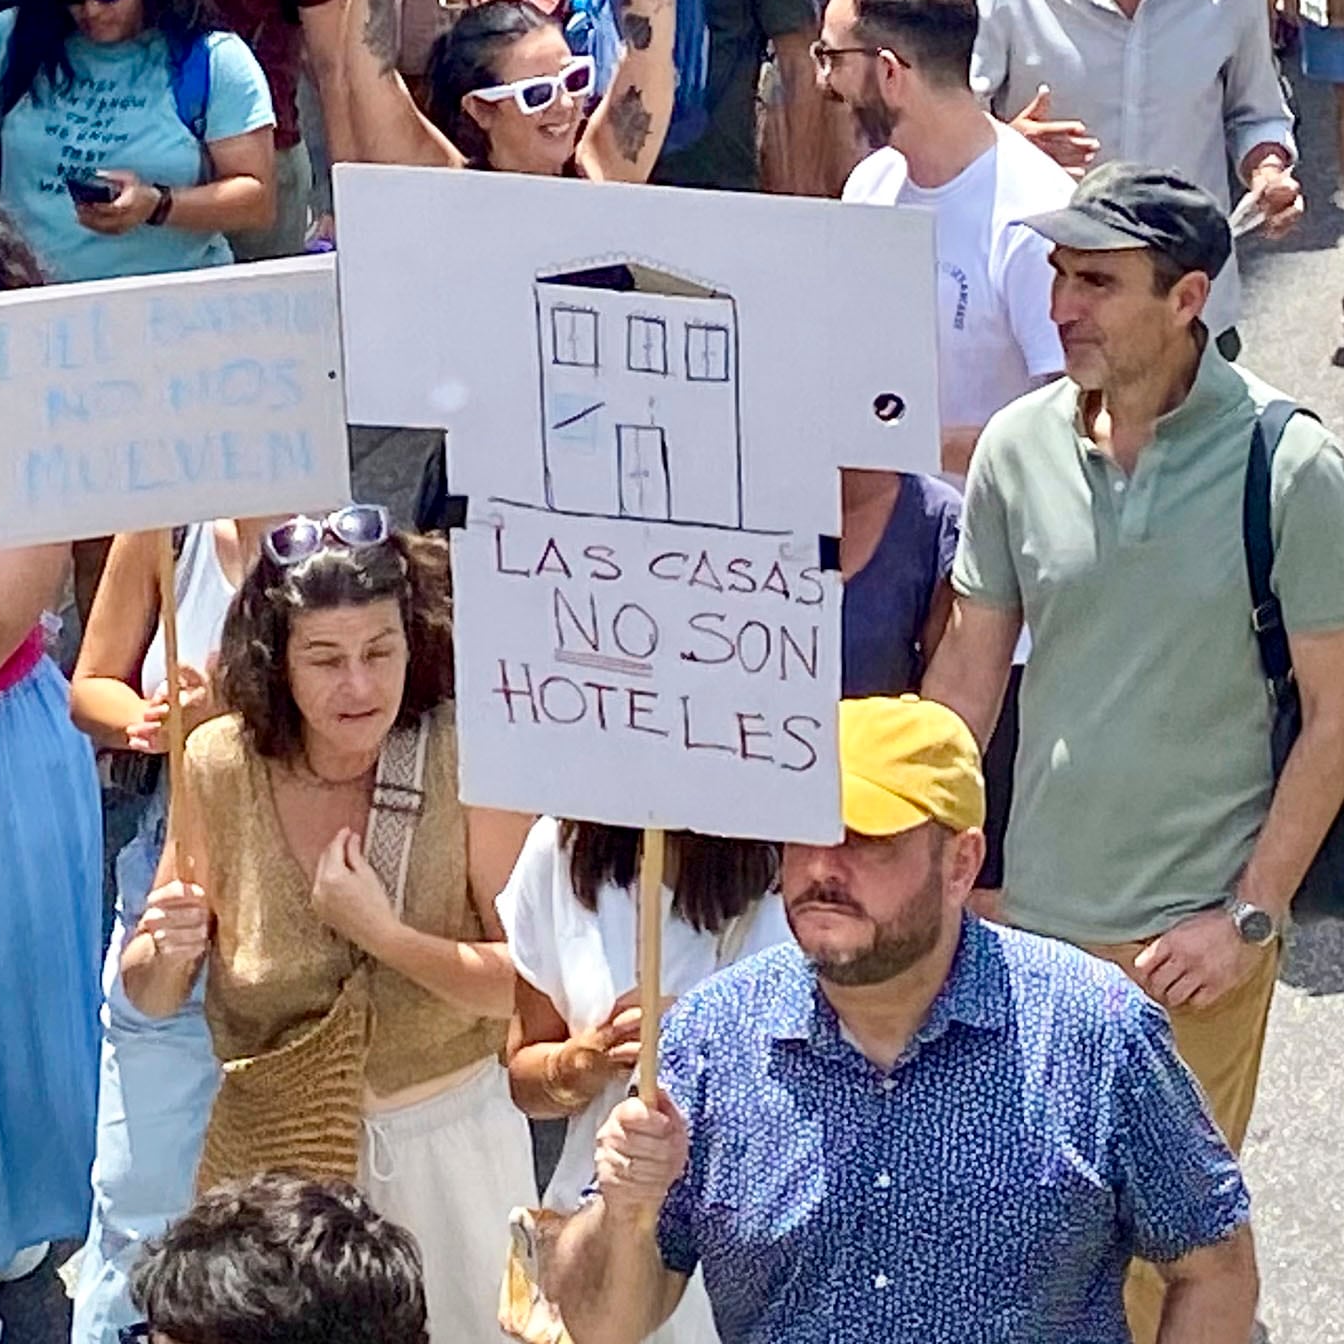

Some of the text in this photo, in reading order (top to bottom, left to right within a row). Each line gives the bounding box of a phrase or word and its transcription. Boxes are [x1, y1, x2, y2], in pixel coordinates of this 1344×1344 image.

[494, 524, 826, 607] LAS CASAS
[554, 586, 821, 682] NO SON
[492, 658, 823, 773] HOTELES
